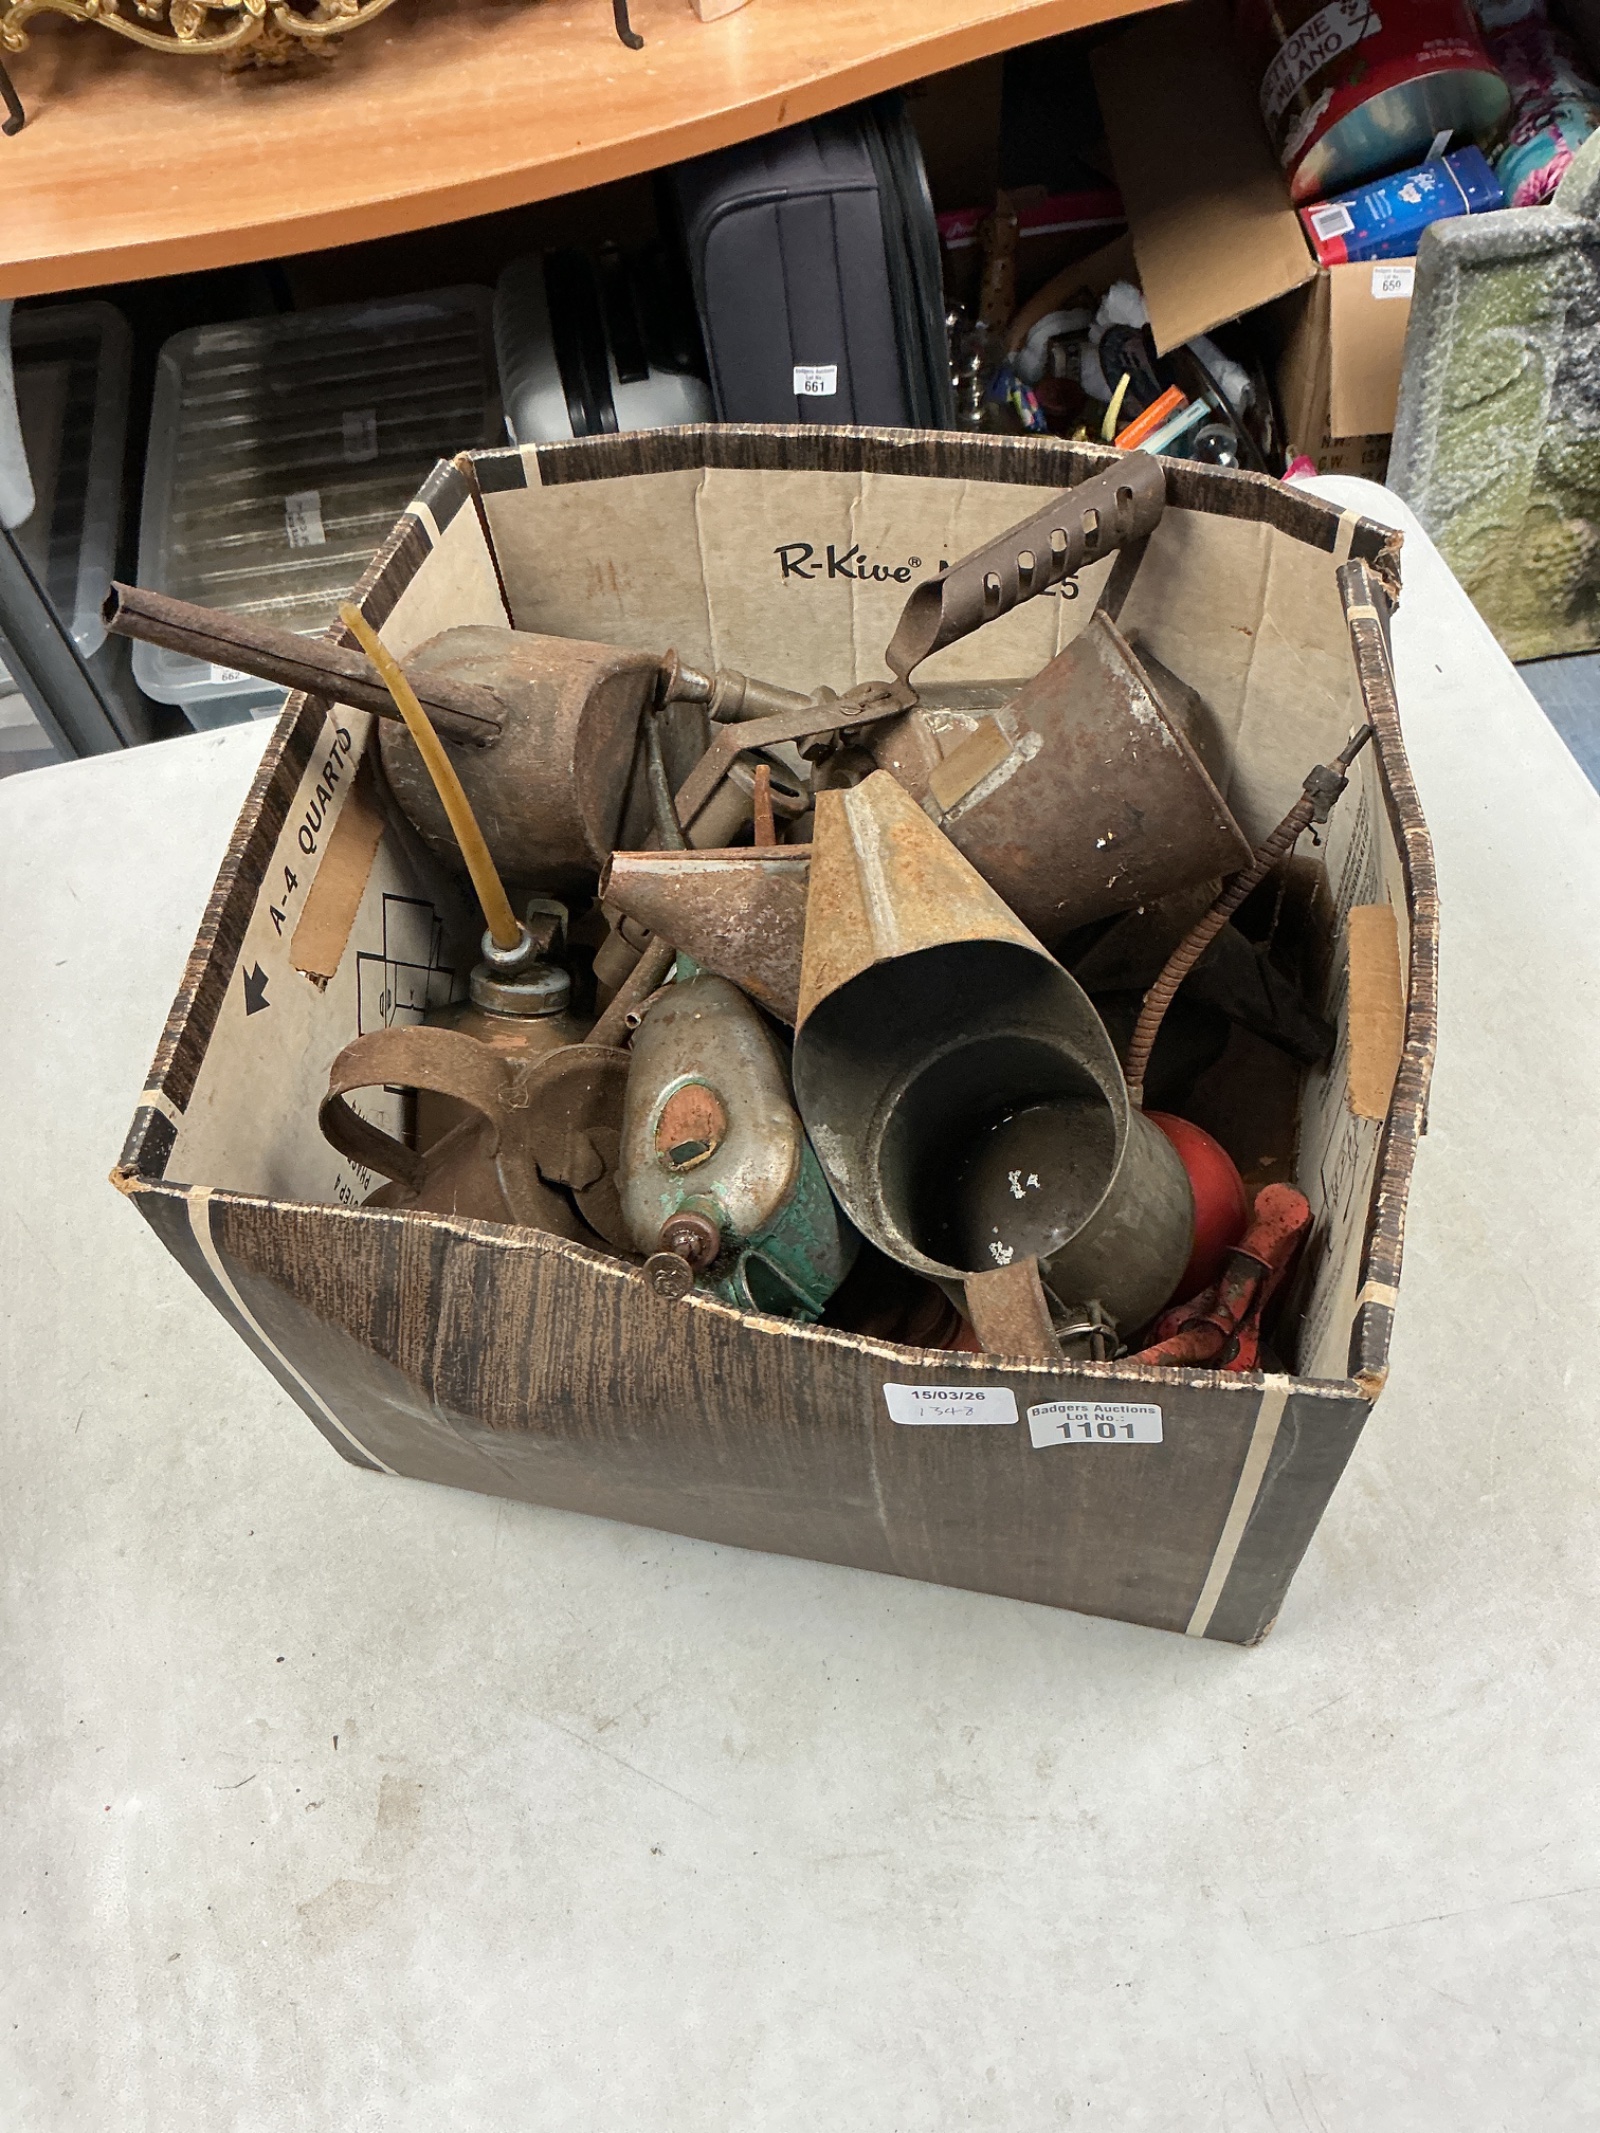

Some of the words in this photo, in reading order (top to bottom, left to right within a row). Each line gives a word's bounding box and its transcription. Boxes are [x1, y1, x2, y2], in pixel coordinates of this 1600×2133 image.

[804, 381, 825, 393] 661
[269, 865, 299, 937] A-4
[910, 1389, 986, 1401] 15/03/26
[1032, 1404, 1089, 1416] Badgers
[1093, 1404, 1156, 1414] Auctions
[1066, 1413, 1089, 1421] Lot
[1056, 1421, 1135, 1439] 1101
